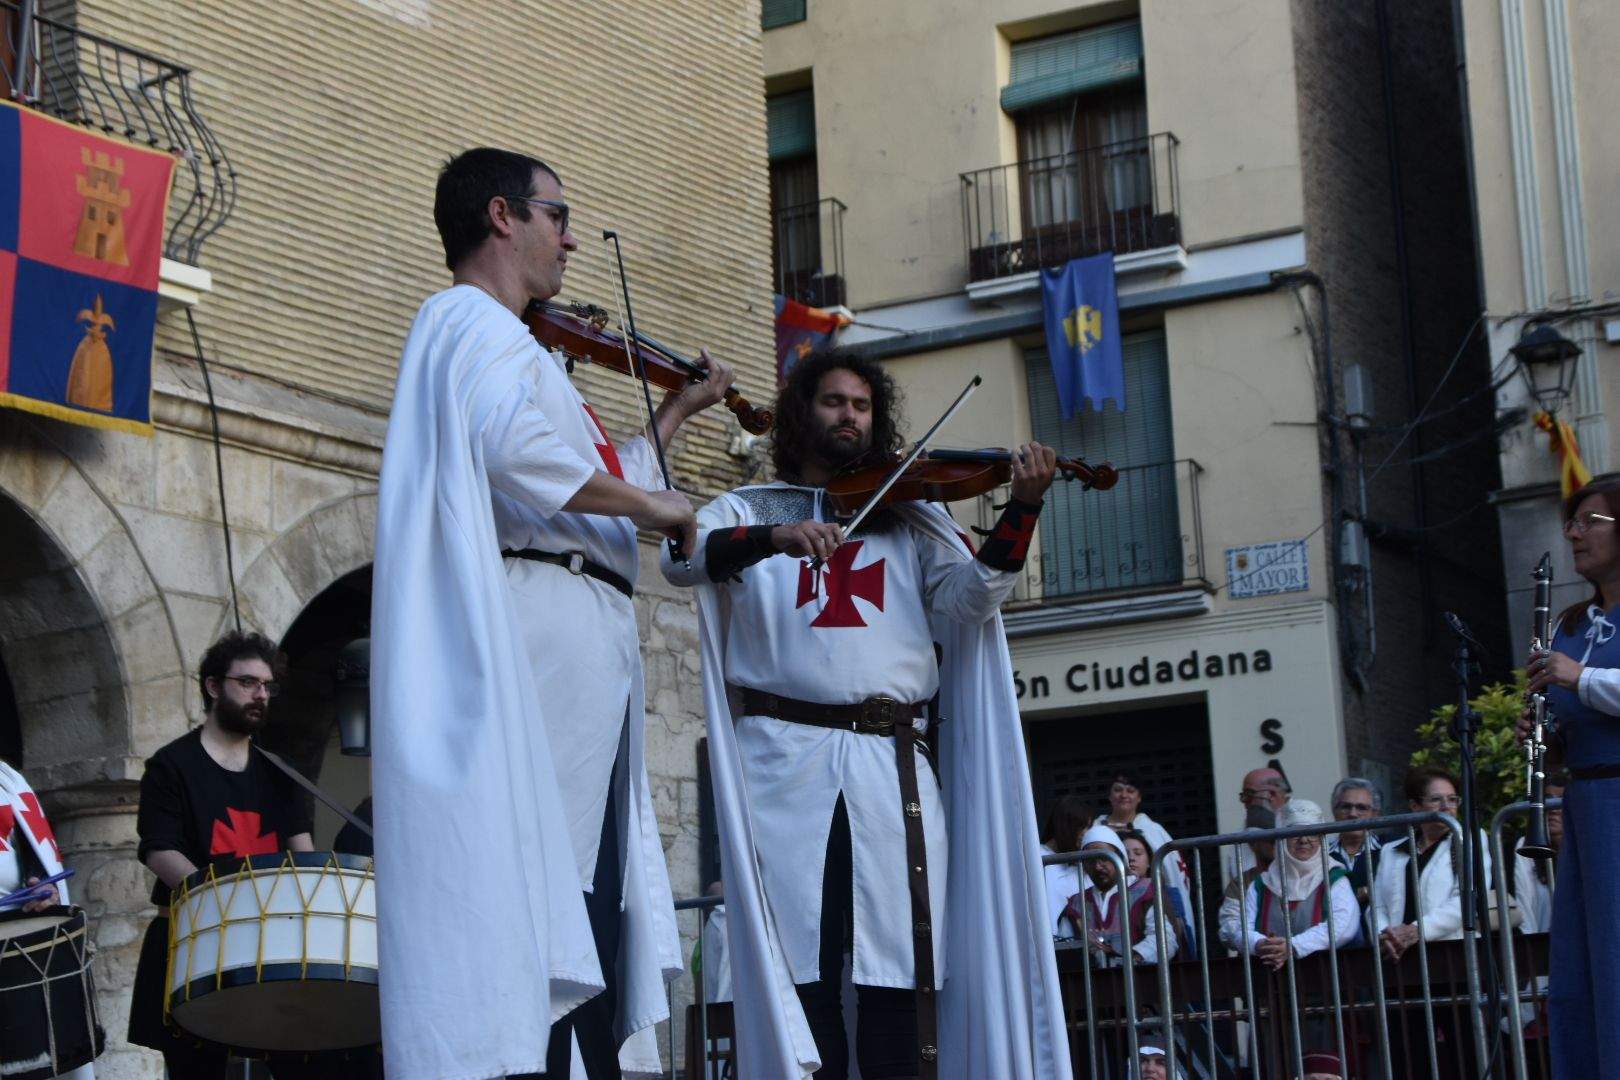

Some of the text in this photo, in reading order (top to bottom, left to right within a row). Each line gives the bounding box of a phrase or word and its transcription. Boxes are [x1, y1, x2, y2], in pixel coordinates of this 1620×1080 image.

[1256, 548, 1299, 567] CALLE
[1240, 567, 1299, 591] MAYOR
[1065, 649, 1273, 693] Ciudadana
